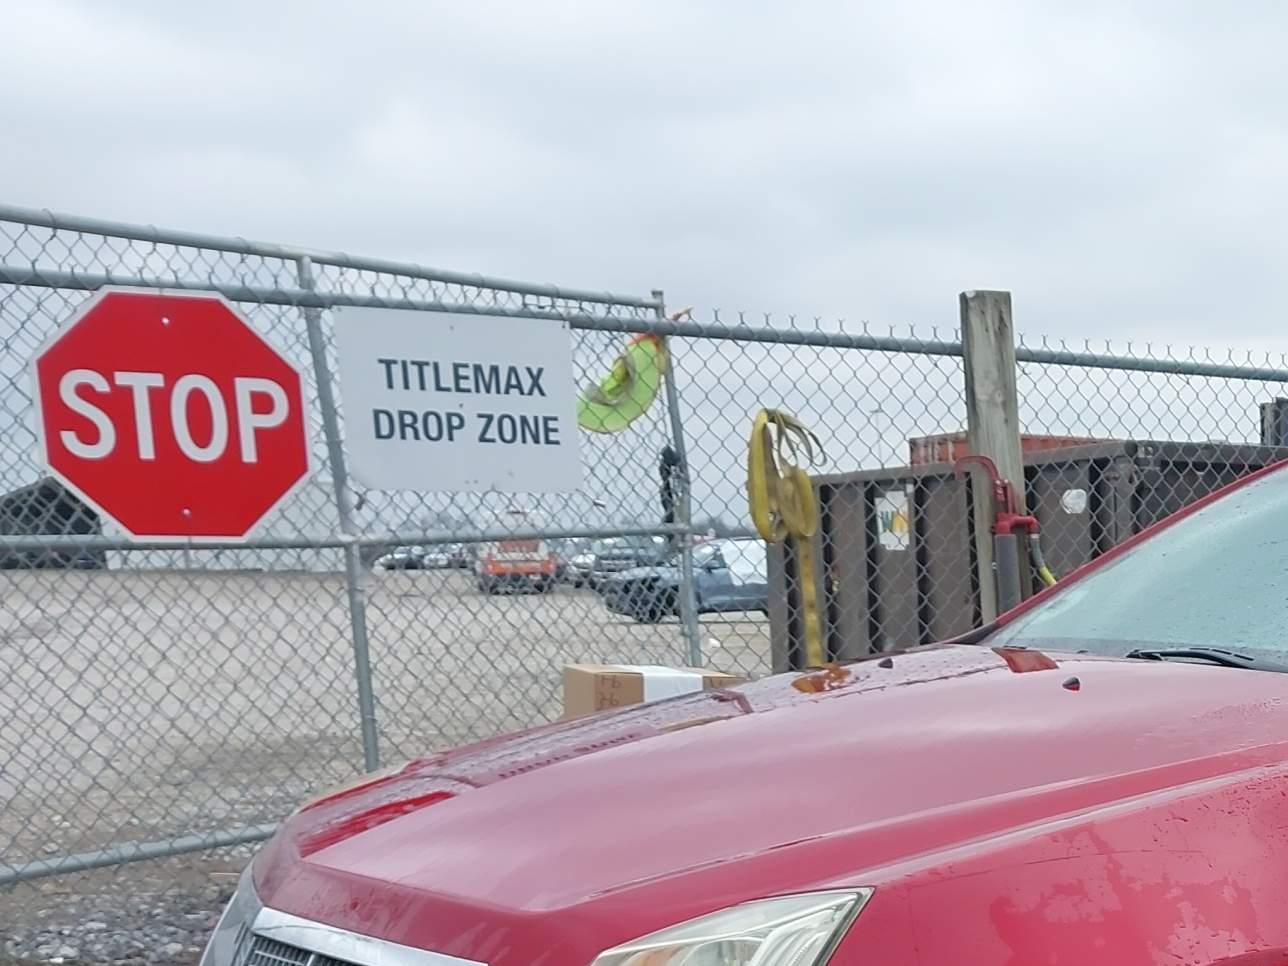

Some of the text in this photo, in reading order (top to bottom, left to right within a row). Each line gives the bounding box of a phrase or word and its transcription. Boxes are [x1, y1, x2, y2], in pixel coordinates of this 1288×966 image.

[377, 358, 547, 397] TITLEMAX
[58, 368, 290, 463] STOP
[372, 408, 561, 445] DROP ZONE
